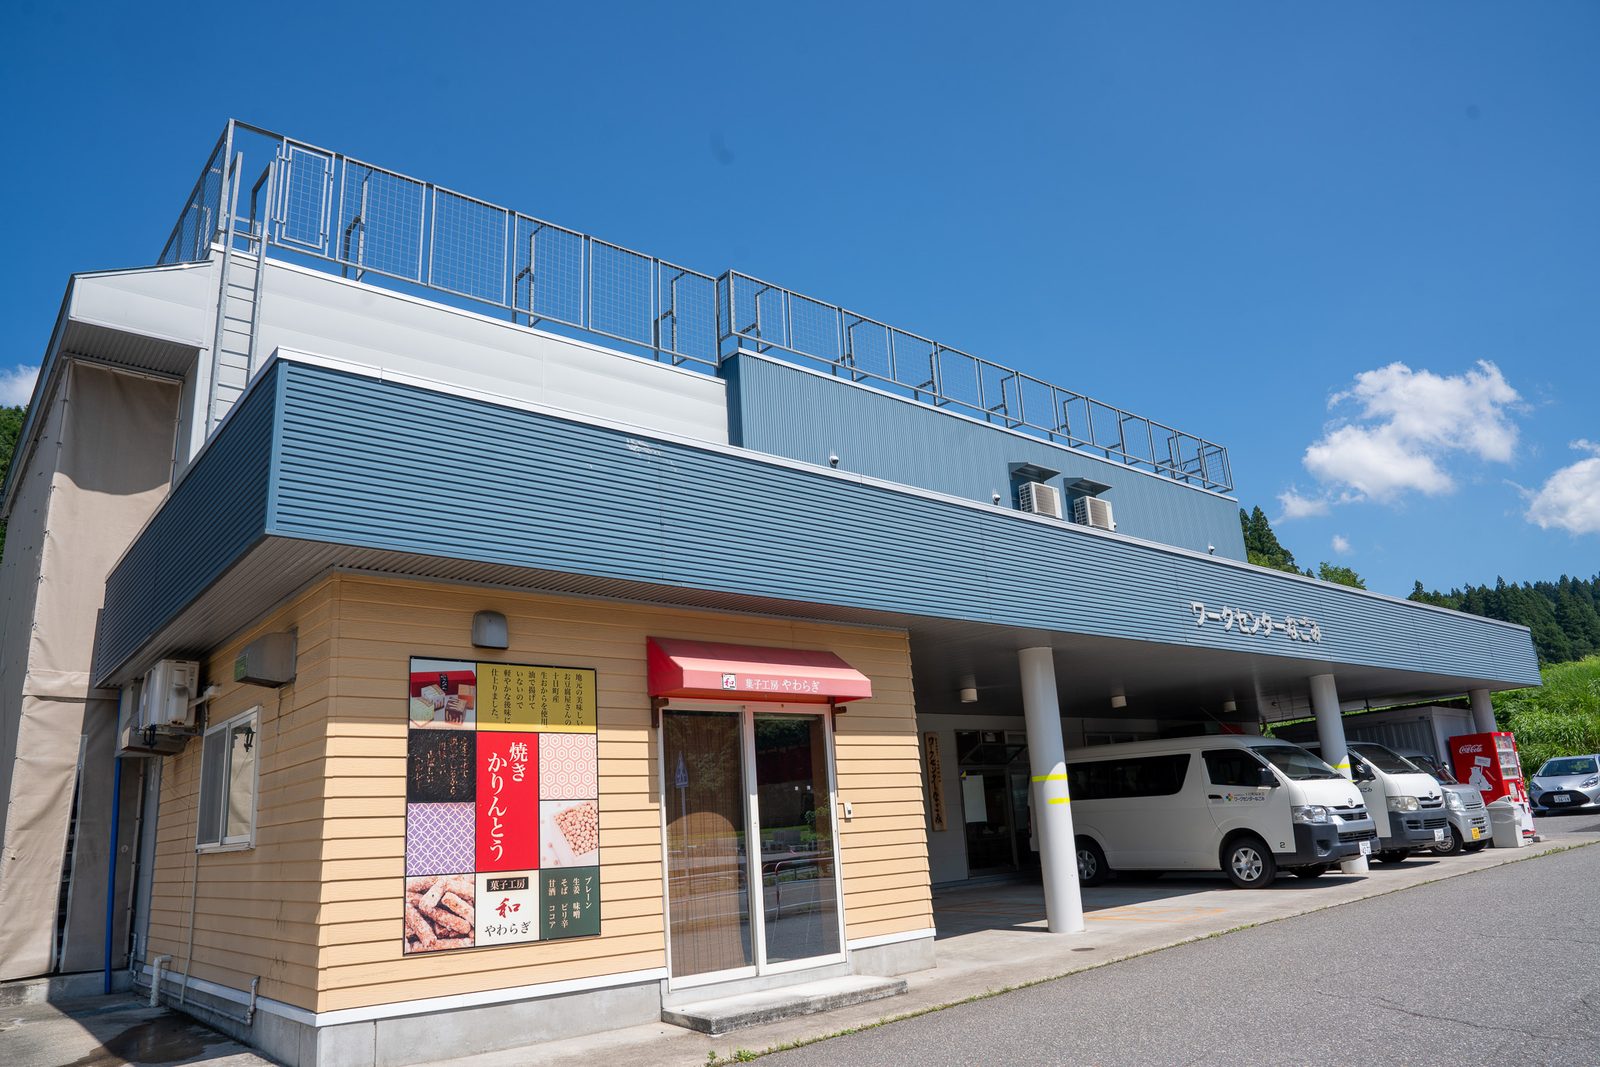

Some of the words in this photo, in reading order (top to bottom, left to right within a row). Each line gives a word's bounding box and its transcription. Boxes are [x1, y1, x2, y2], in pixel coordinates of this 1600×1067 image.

[1190, 601, 1321, 644] ワークセンターなごみ
[745, 678, 779, 691] 菓子工房
[782, 679, 820, 693] やわらぎ
[503, 669, 511, 724] 軽やかな後味に
[564, 673, 572, 726] お豆腐屋さんの
[575, 673, 583, 726] 地元の美味しい
[1459, 743, 1483, 755] Coca-Cola
[508, 741, 529, 782] 焼き
[487, 752, 508, 862] かりんとう
[1279, 841, 1286, 849] 2
[490, 878, 526, 891] 菓子工房
[548, 879, 556, 896] 甘酒
[560, 878, 569, 895] そば
[572, 877, 580, 895] 生姜
[495, 897, 521, 918] 和
[548, 905, 556, 929] ココア
[561, 902, 569, 929] ピリ辛
[572, 901, 581, 919] 味噌
[484, 920, 532, 937] やわらぎ
